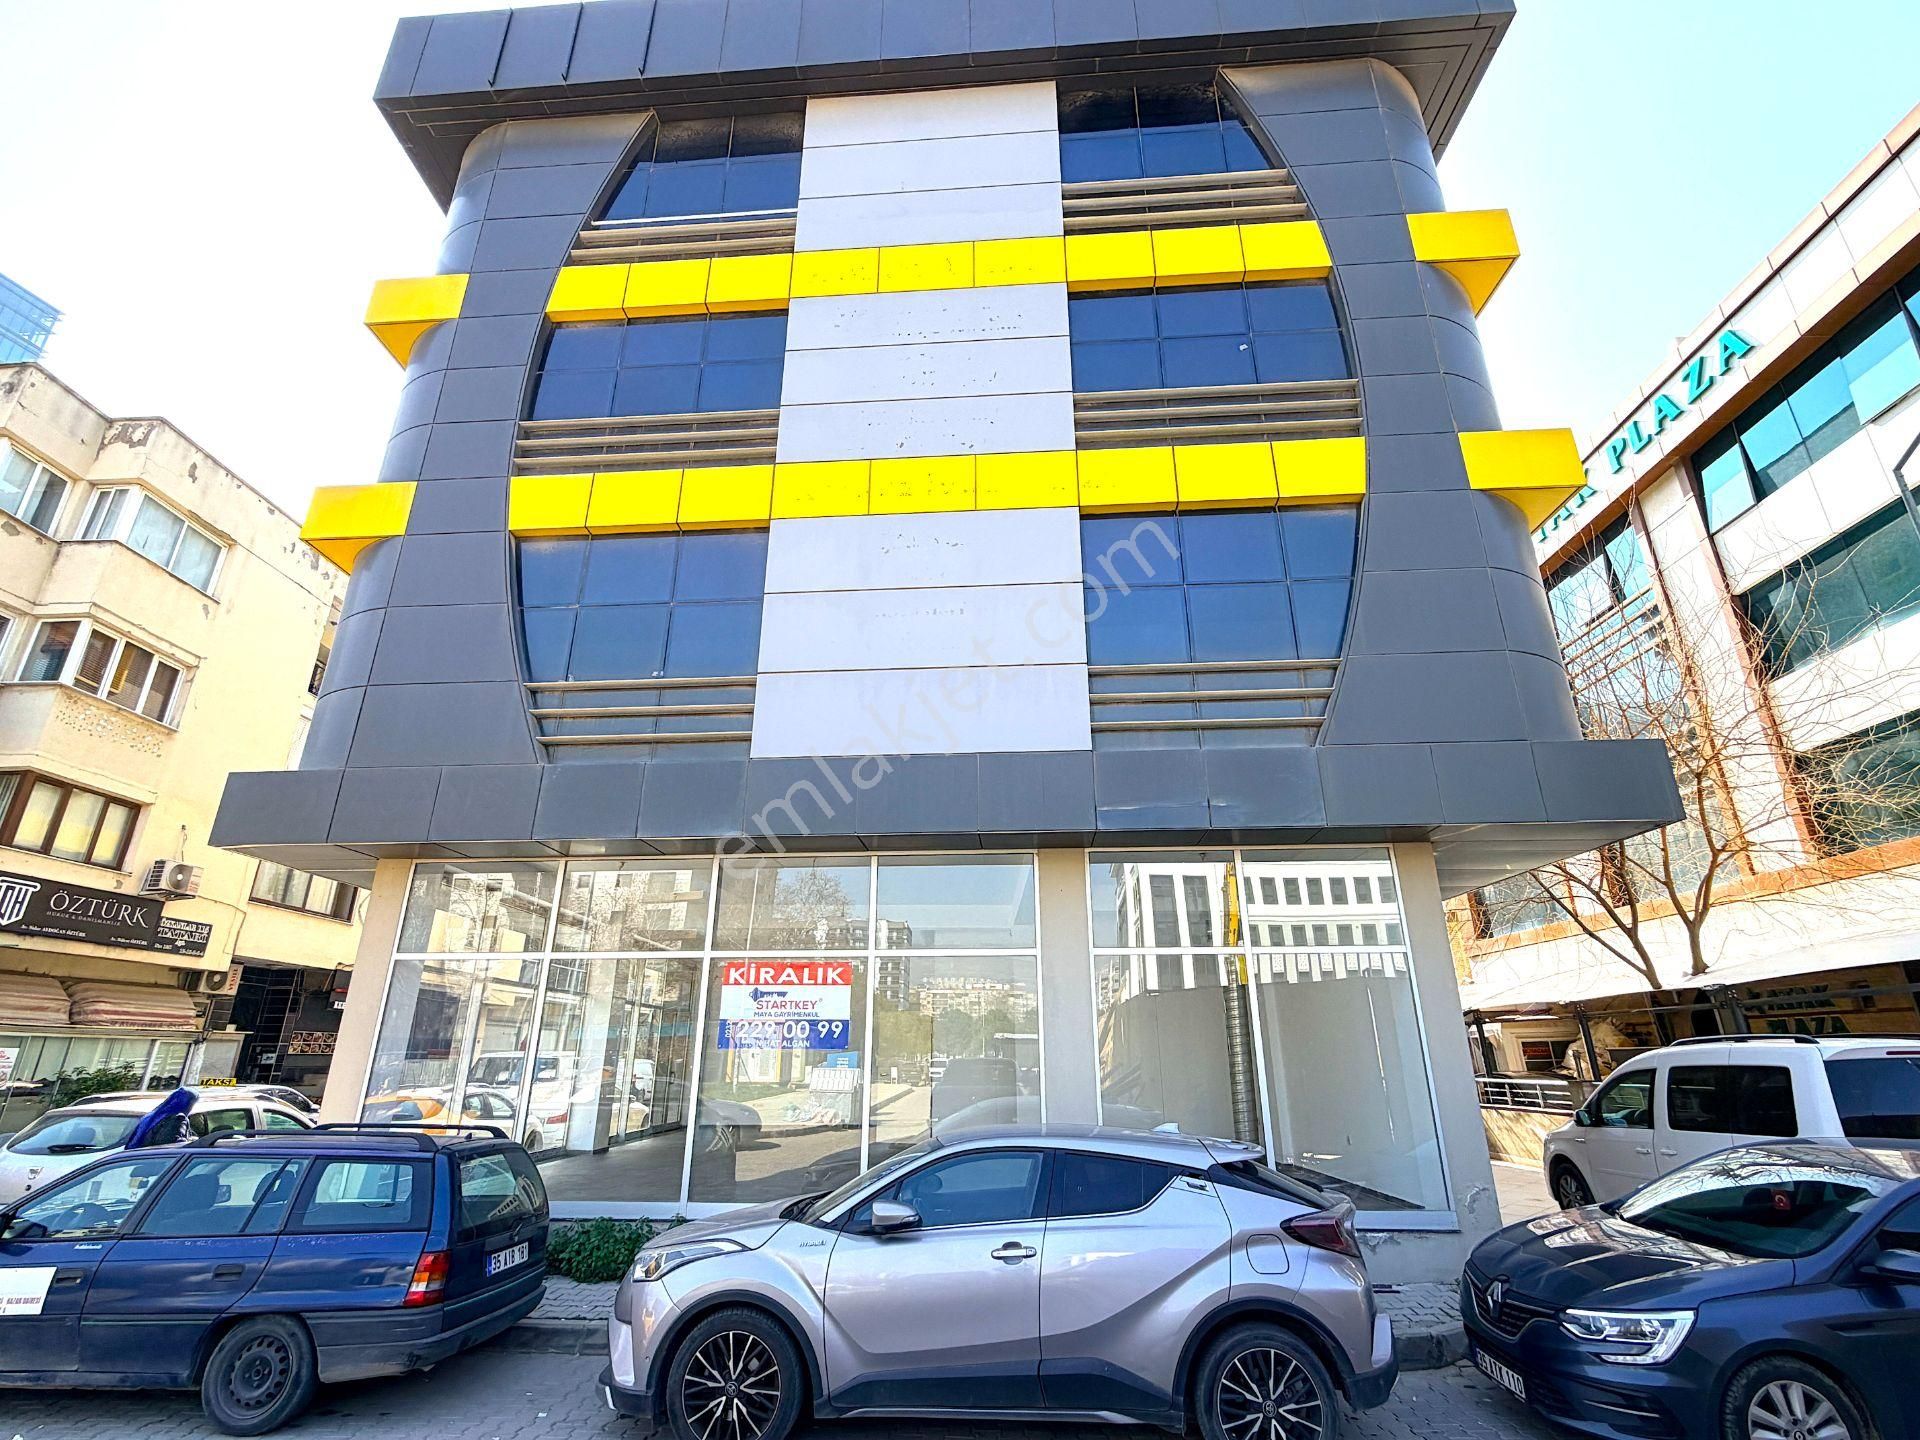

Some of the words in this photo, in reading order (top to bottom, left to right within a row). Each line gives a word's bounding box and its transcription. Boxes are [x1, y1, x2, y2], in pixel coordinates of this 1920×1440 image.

[1605, 329, 1755, 474] PLAZA
[50, 890, 149, 928] ÖZTÜRK
[728, 963, 845, 984] KİRALIK
[756, 1000, 818, 1010] STARTKEY
[736, 1020, 776, 1039] 229
[783, 1020, 810, 1039] 00
[817, 1020, 844, 1039] 99
[782, 1039, 810, 1048] ALGAN
[493, 1255, 501, 1271] 35
